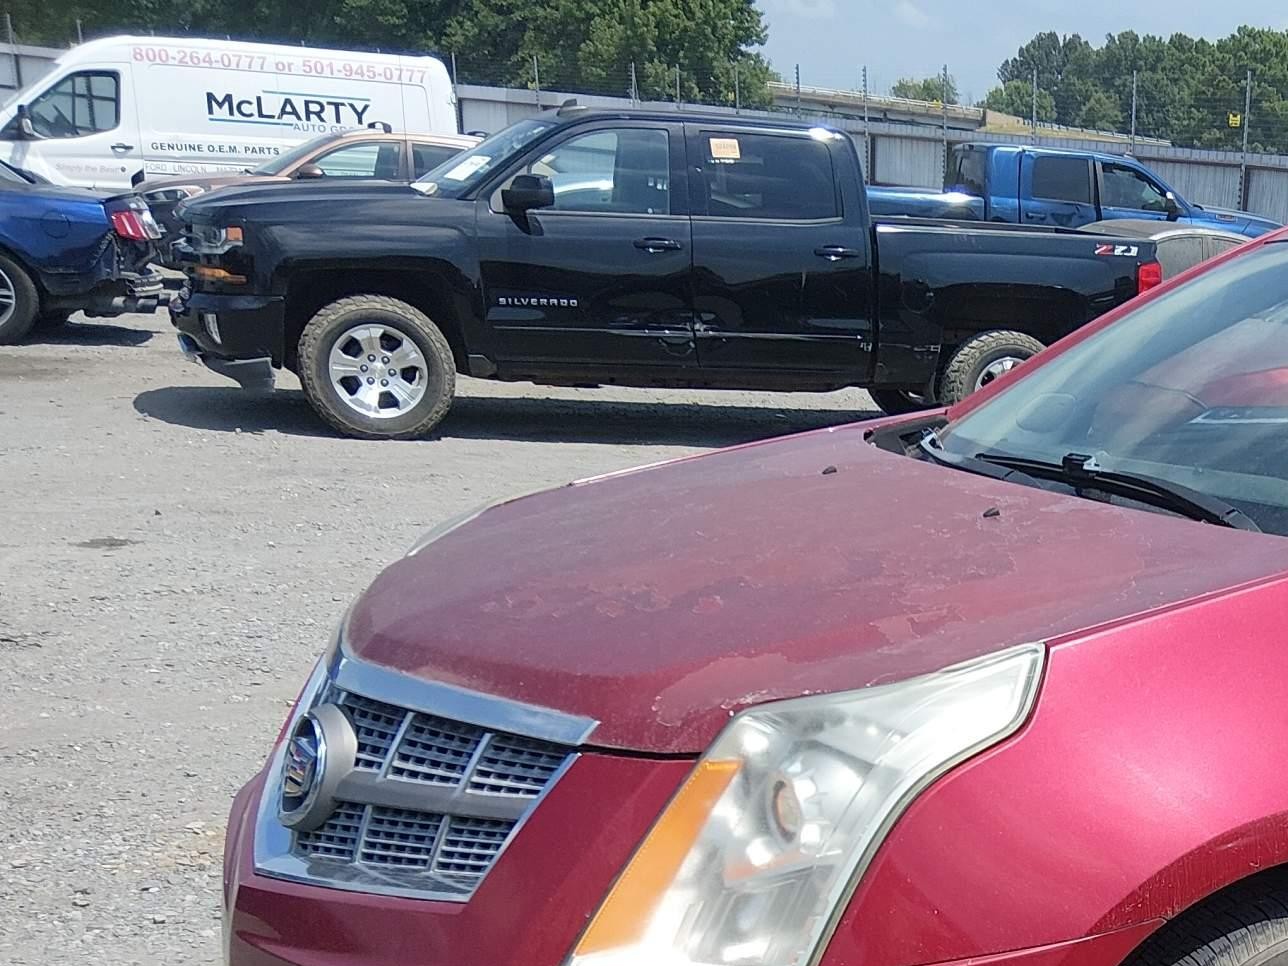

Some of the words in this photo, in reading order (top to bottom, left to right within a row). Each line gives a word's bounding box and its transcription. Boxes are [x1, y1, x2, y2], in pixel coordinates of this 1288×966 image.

[132, 47, 267, 71] 800-264-0777
[274, 60, 294, 73] or
[302, 59, 427, 84] 501-945-0777
[206, 91, 370, 126] McLARTY
[294, 123, 326, 133] AUTO
[151, 142, 204, 153] GENUINE
[207, 144, 240, 154] O.E.M.
[244, 146, 280, 156] PARTS
[498, 297, 578, 307] SILVERADO
